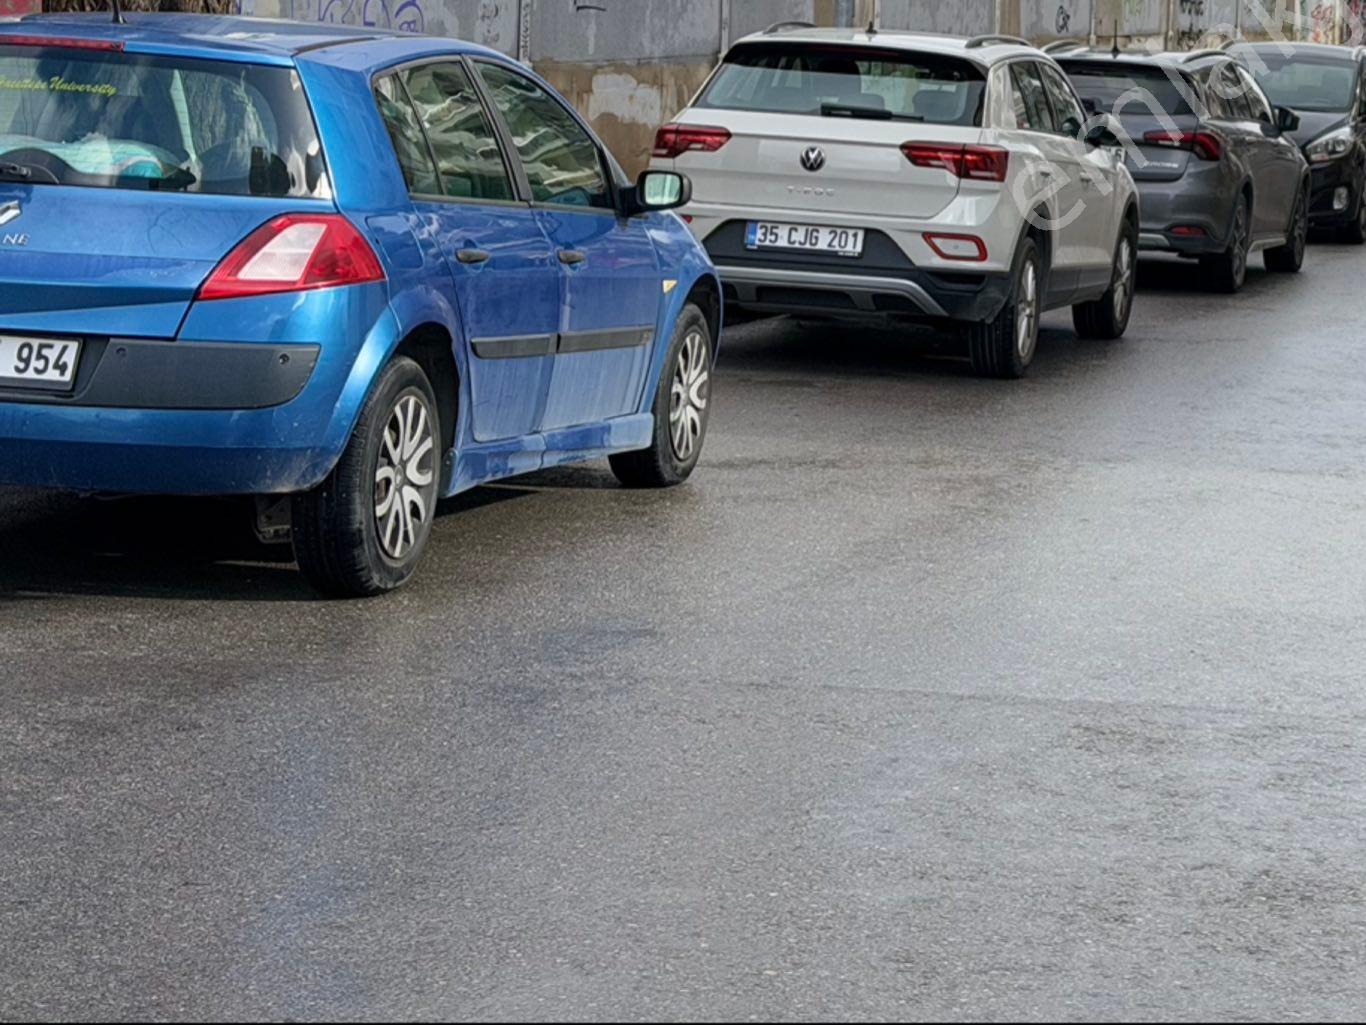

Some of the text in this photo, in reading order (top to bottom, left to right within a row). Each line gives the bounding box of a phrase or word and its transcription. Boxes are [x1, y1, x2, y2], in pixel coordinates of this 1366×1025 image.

[50, 76, 118, 97] University
[757, 224, 859, 250] 35 CJG 201
[14, 342, 69, 376] 954
